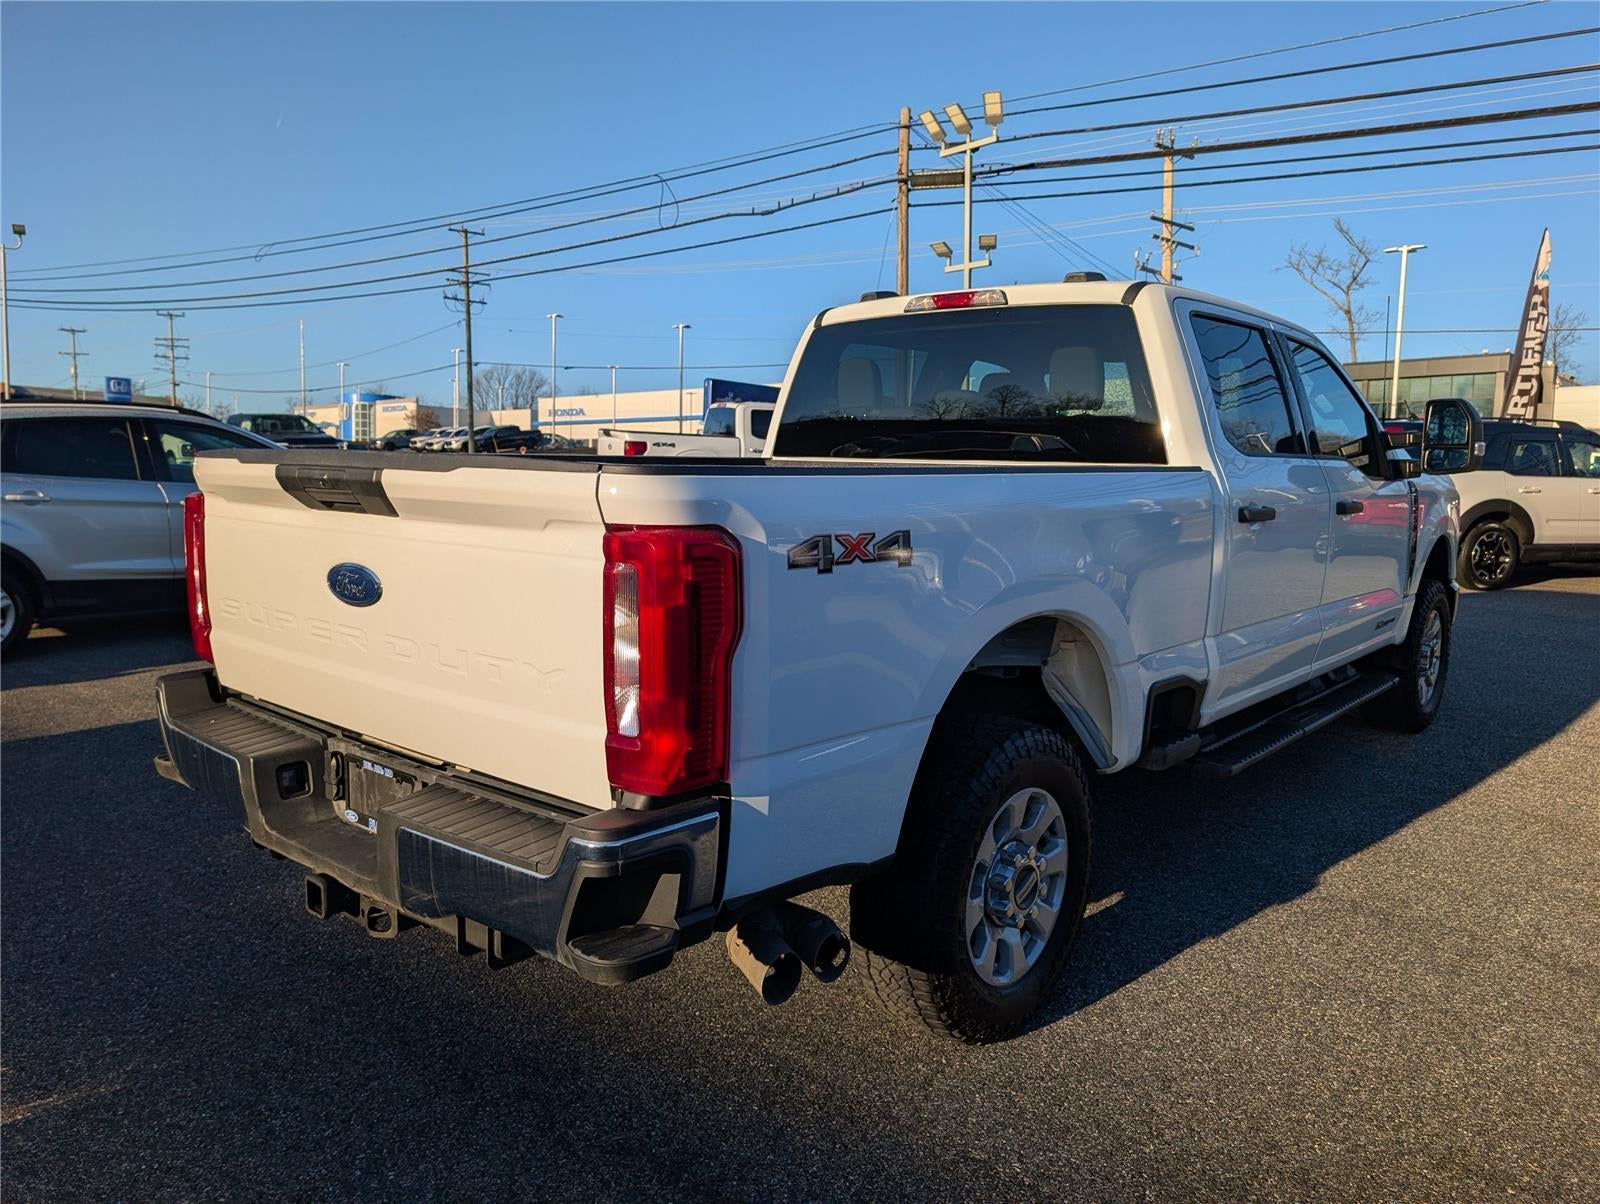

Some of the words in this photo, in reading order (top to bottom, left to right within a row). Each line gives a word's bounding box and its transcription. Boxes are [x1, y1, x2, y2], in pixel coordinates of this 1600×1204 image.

[548, 408, 586, 417] HONDA
[336, 571, 366, 599] Ford
[220, 596, 369, 656] SUPER
[385, 632, 567, 694] DUTY
